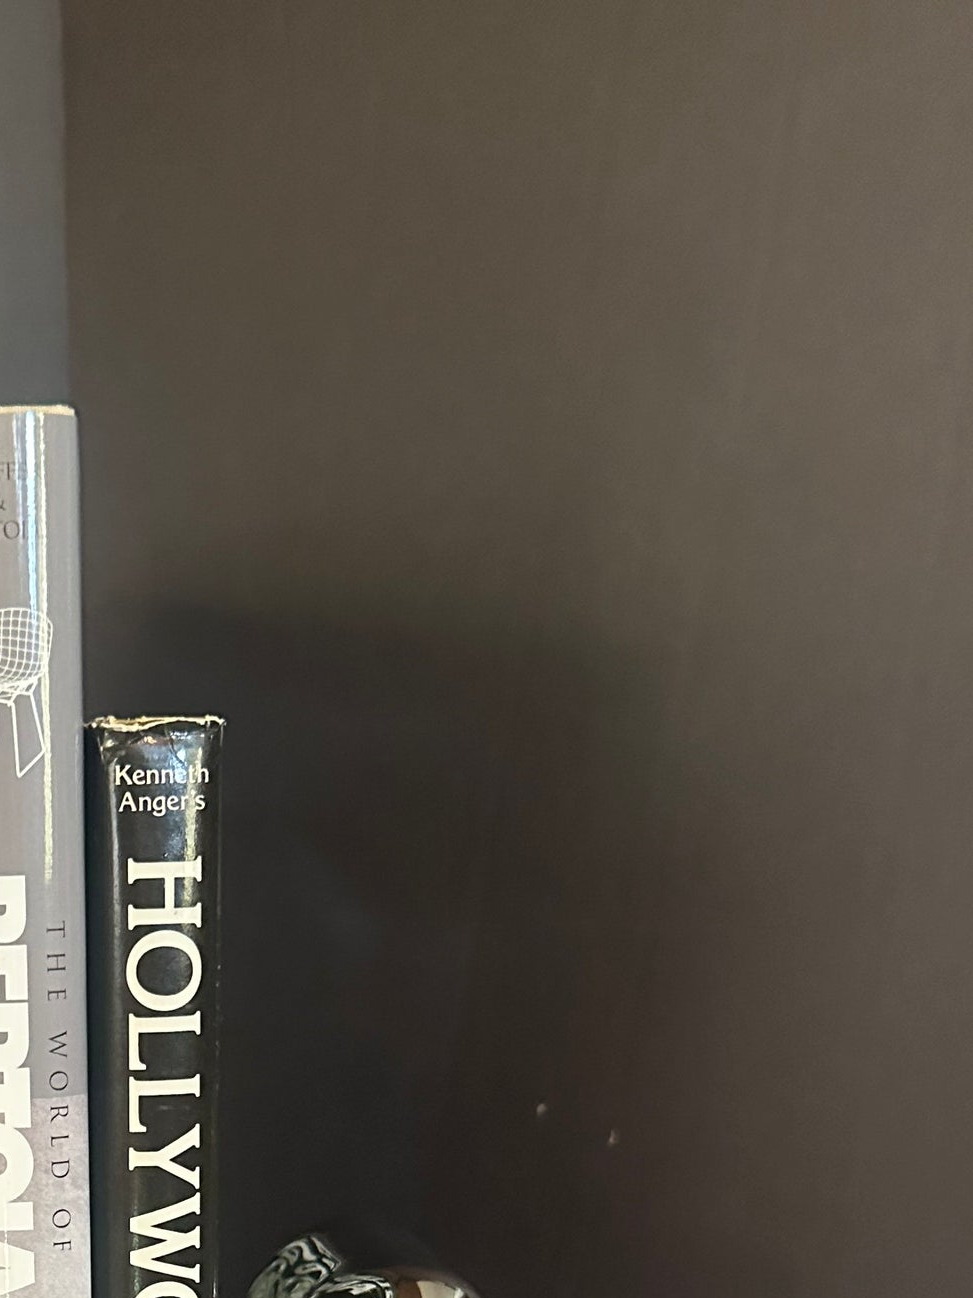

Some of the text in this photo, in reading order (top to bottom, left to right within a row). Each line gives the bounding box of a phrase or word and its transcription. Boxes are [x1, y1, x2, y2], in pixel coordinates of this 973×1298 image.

[115, 764, 209, 786] Kenneth
[45, 920, 72, 1250] THE WORLD OF
